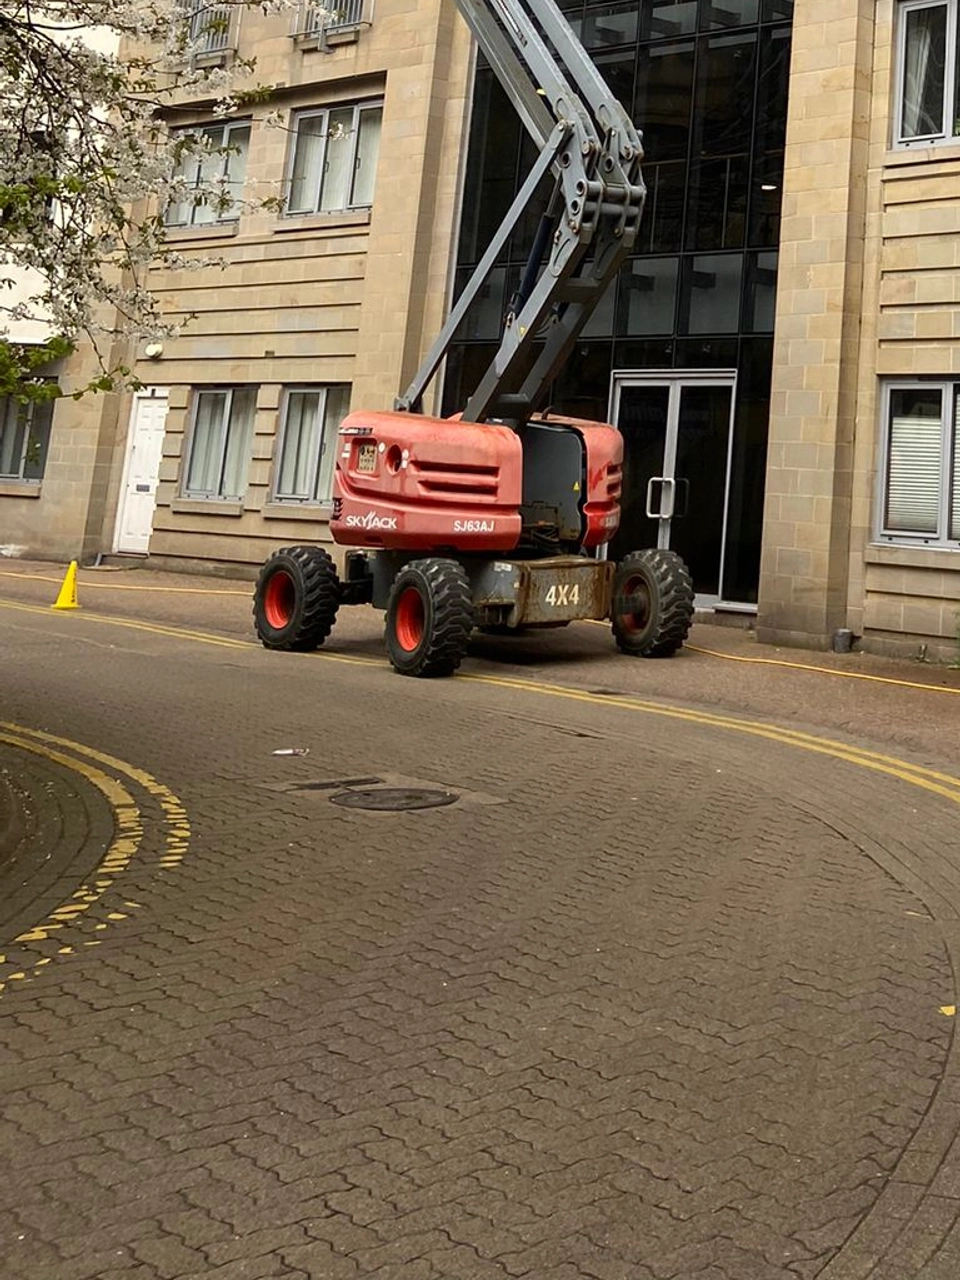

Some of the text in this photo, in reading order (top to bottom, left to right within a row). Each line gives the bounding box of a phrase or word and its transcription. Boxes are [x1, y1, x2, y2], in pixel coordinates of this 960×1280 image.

[345, 510, 397, 530] SKYJACK
[453, 520, 495, 532] SJ63AJ
[545, 584, 580, 607] 4X4
